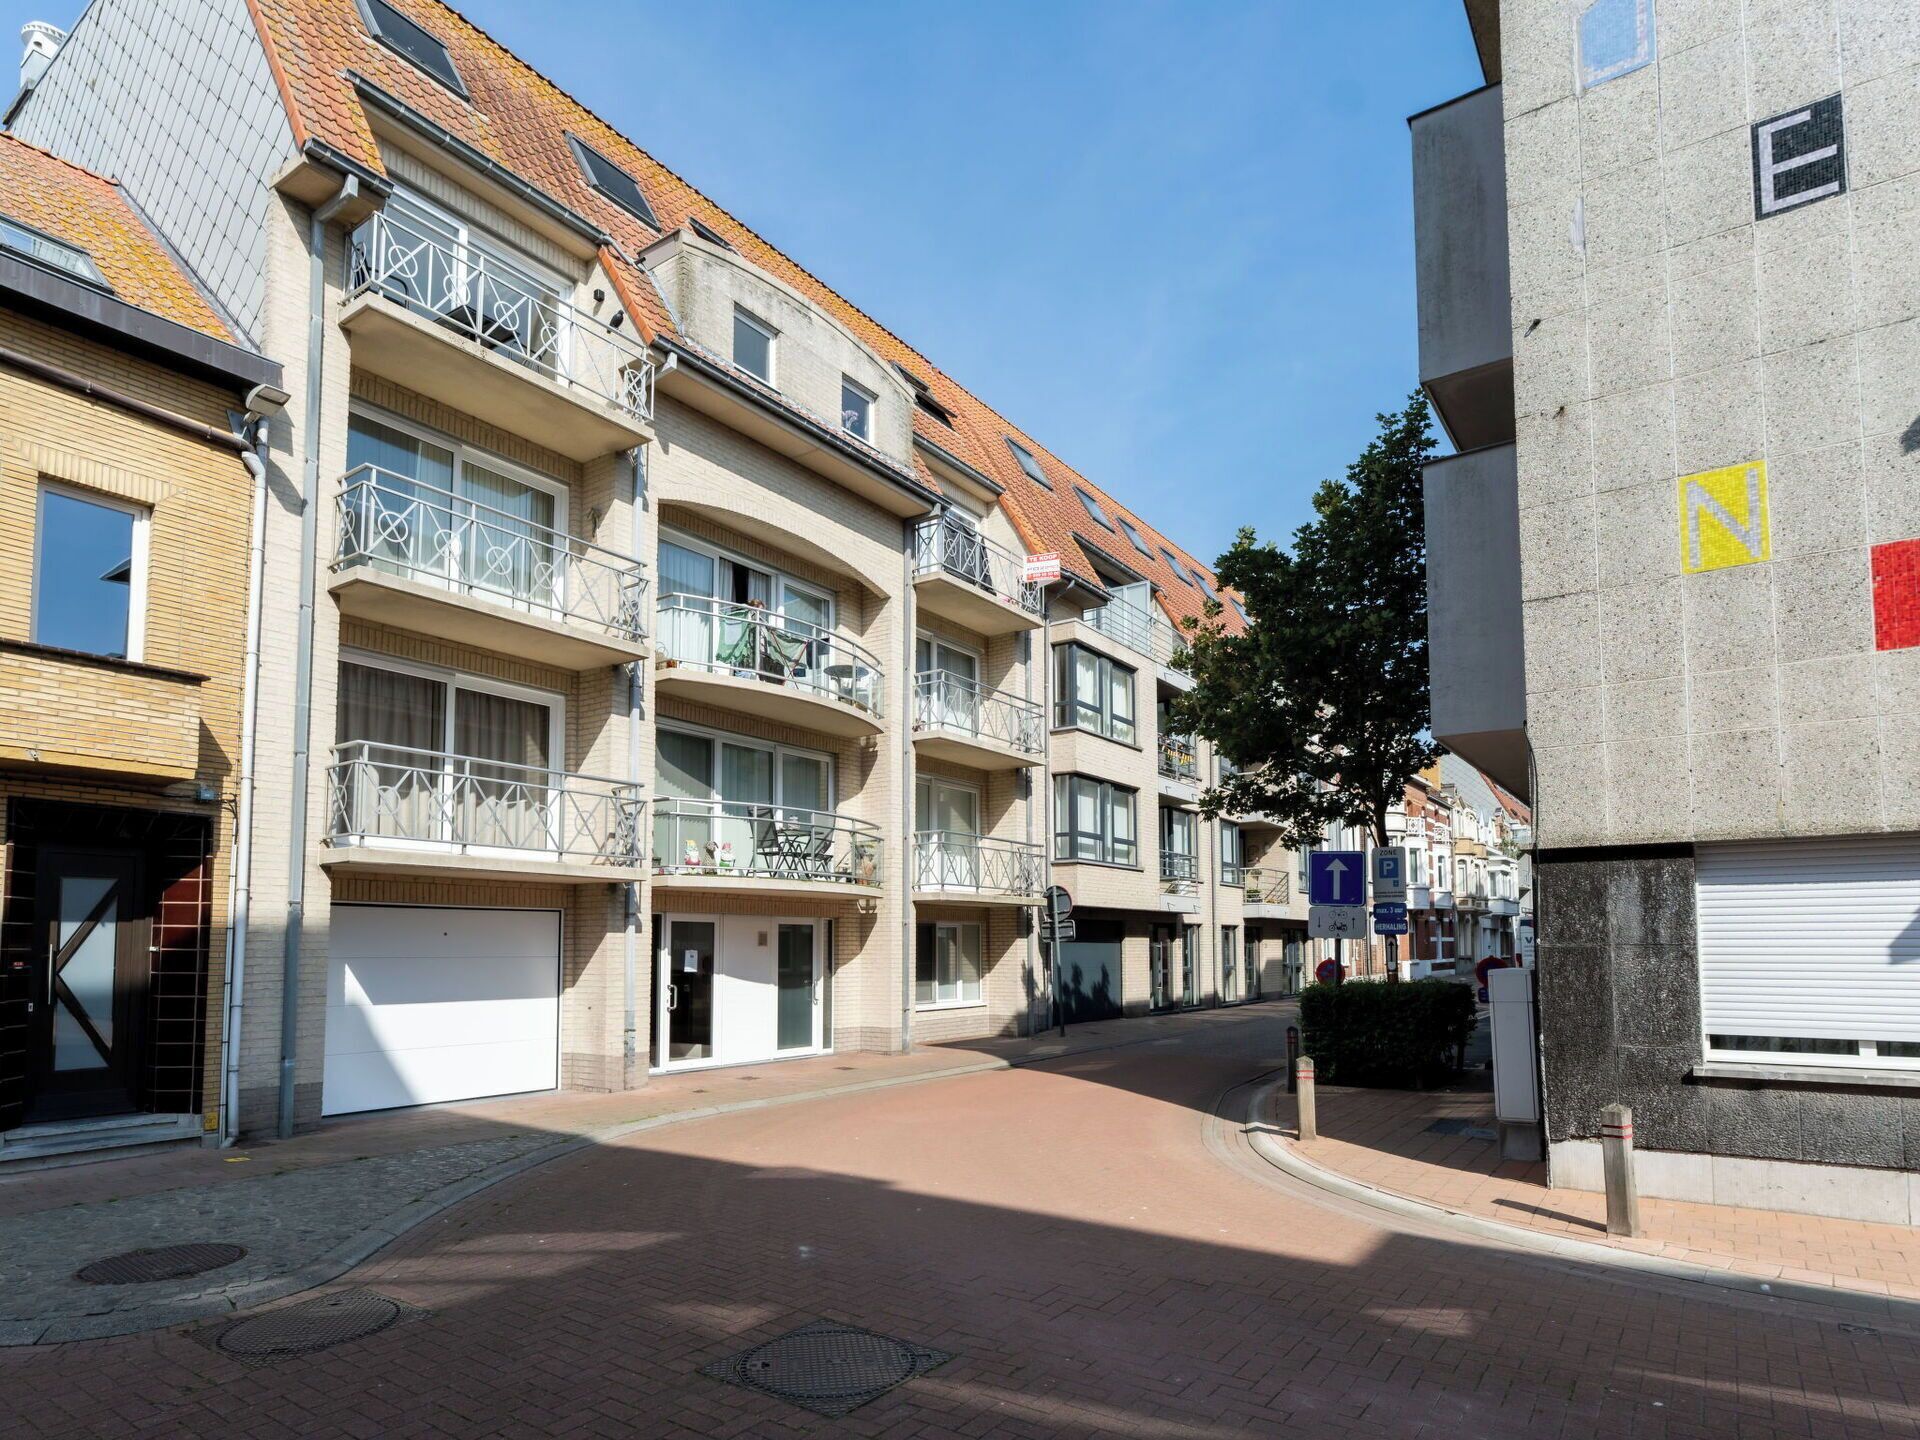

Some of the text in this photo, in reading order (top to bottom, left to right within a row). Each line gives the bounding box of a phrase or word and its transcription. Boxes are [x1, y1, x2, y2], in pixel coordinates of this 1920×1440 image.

[1758, 109, 1840, 214] E
[1686, 468, 1761, 569] N
[1383, 860, 1394, 875] P
